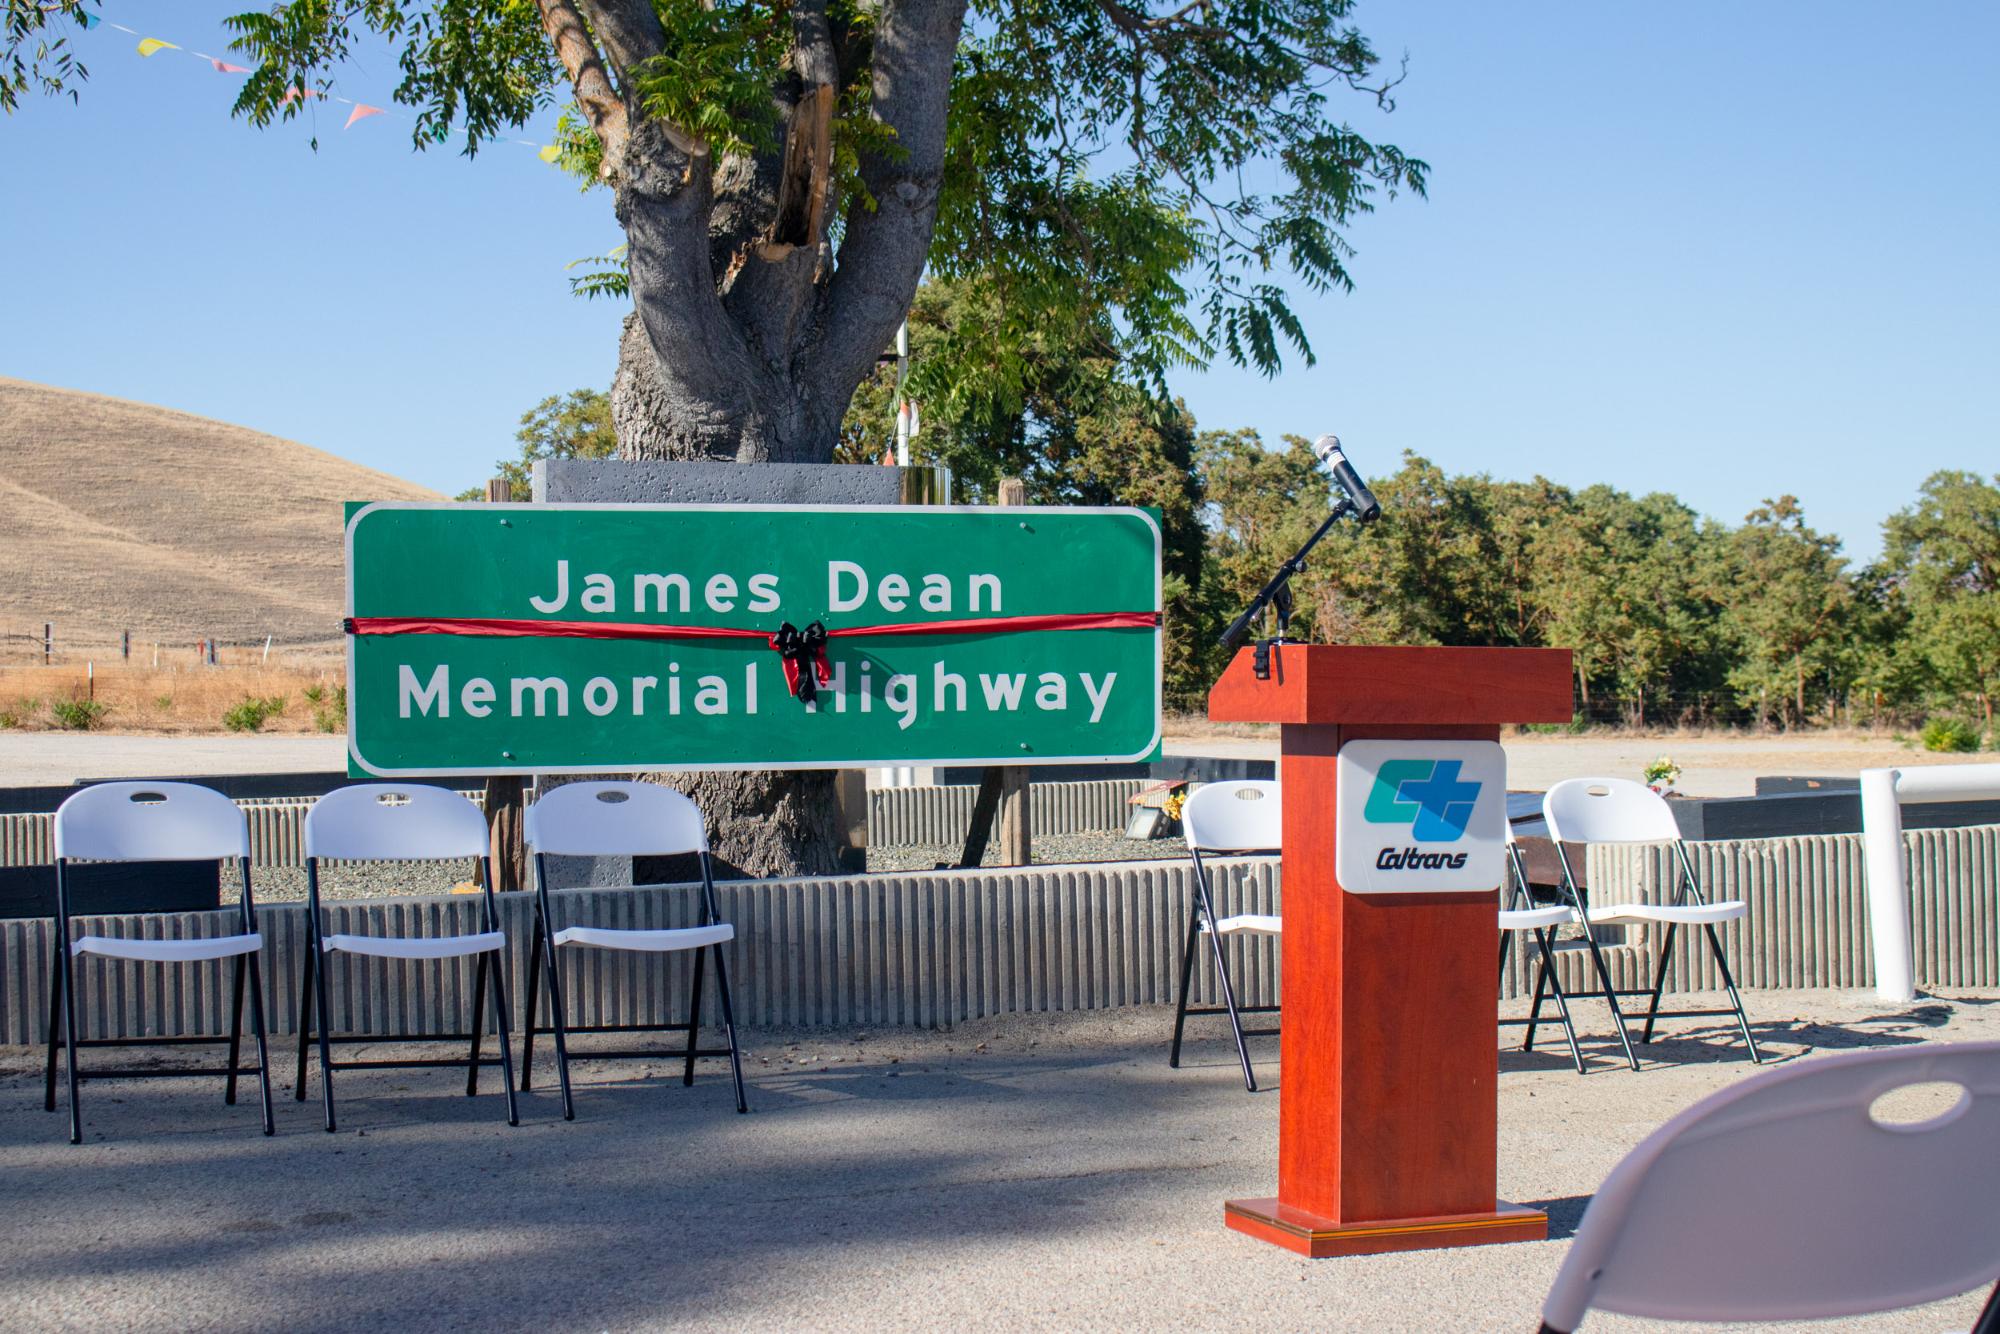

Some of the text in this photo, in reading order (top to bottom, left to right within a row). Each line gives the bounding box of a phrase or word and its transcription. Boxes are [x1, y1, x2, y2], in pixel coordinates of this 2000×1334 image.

[529, 559, 1002, 614] James Dean
[399, 659, 1117, 731] Memorial Highway
[1375, 847, 1468, 870] Caltrans
